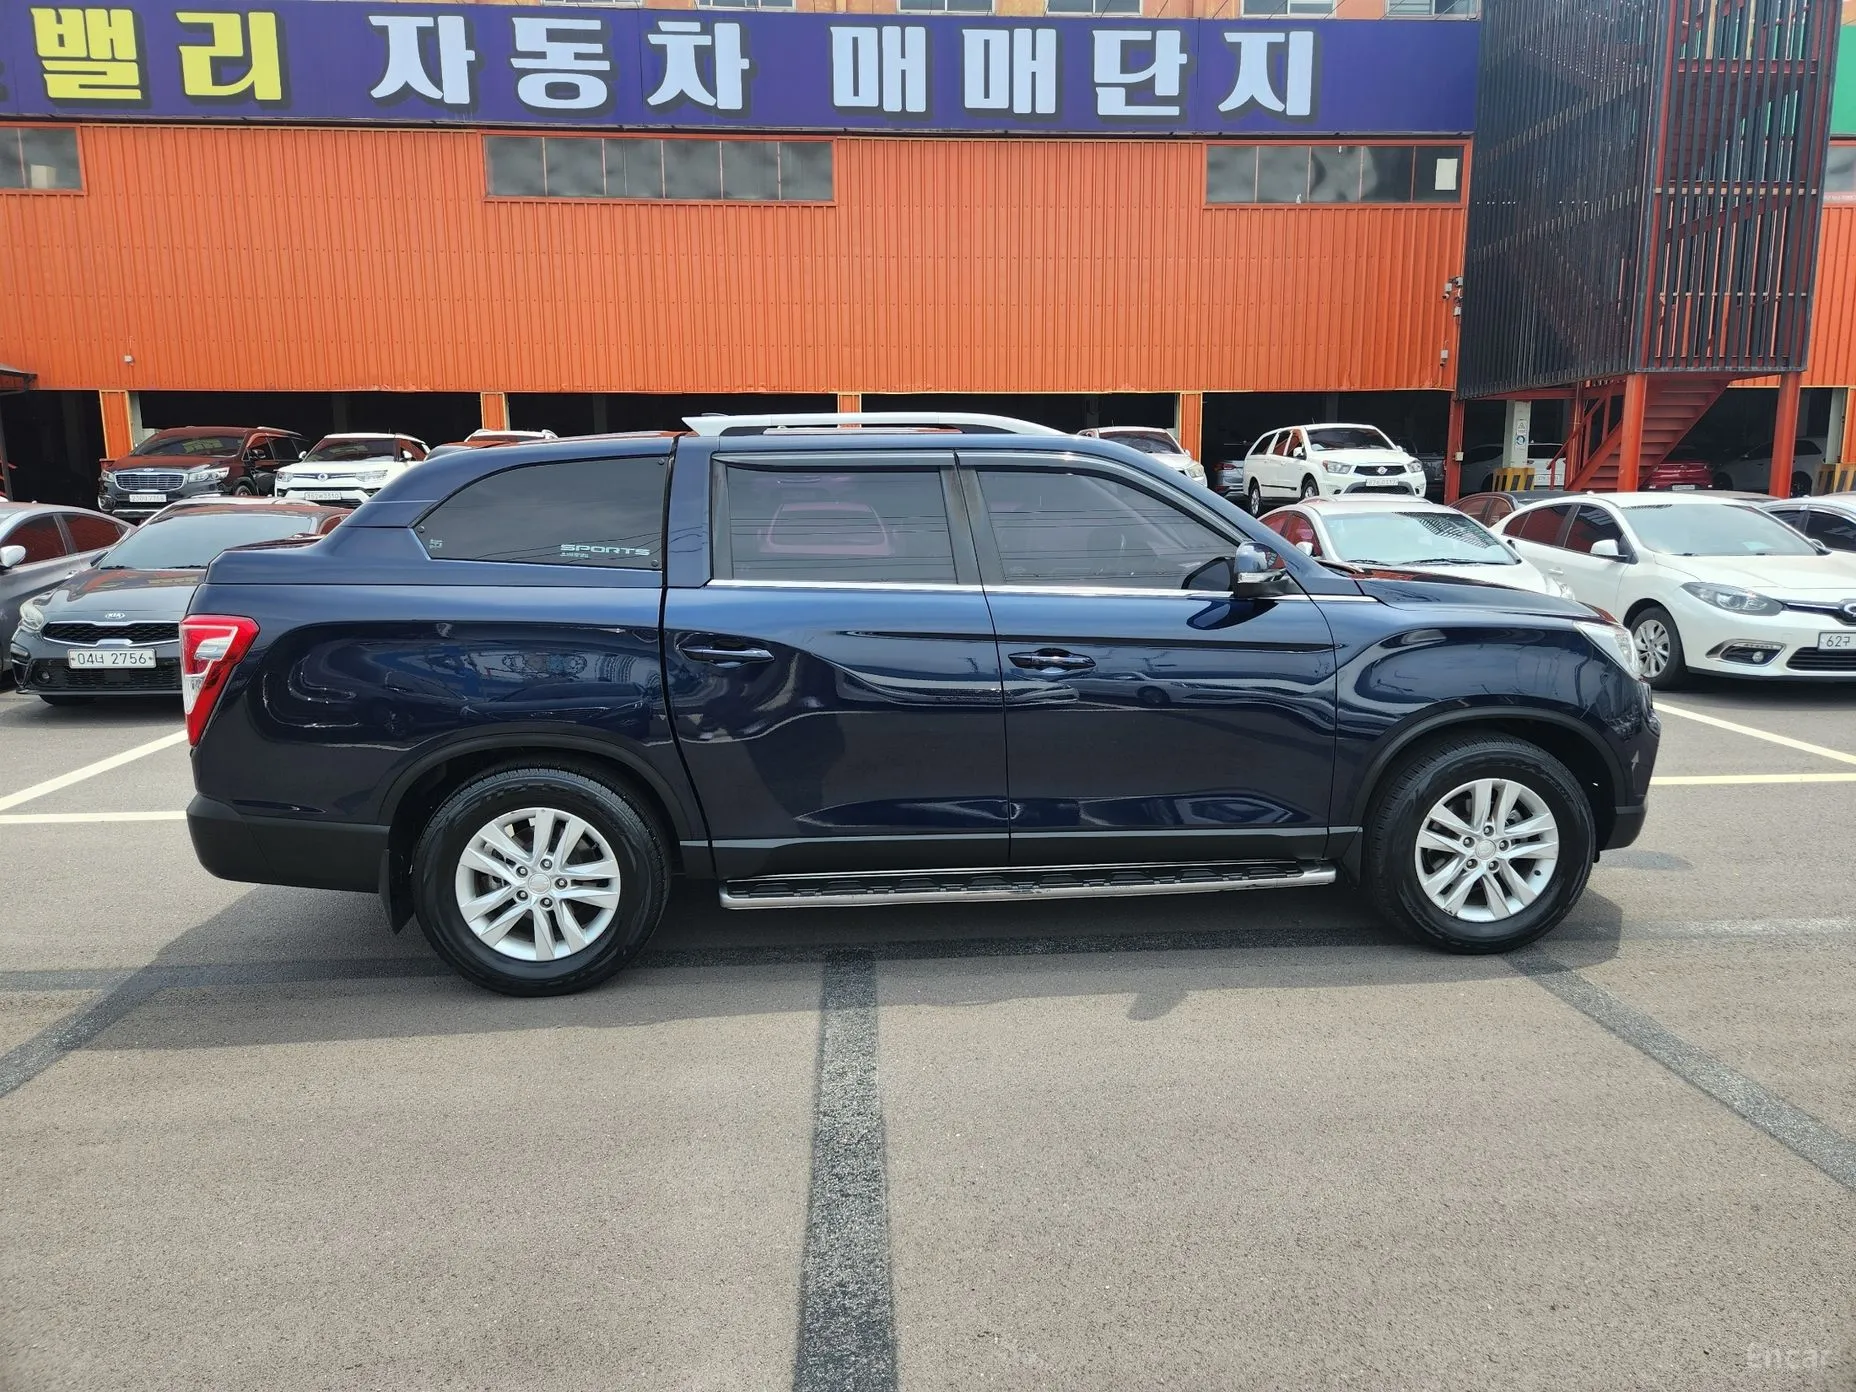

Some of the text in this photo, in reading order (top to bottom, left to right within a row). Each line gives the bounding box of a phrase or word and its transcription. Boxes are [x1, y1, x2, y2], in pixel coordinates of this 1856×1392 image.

[30, 8, 1314, 116] 밸리 자동차 매매단지
[560, 544, 651, 556] SPORTS
[1826, 635, 1851, 648] 62구
[77, 652, 147, 665] 04너 2756
